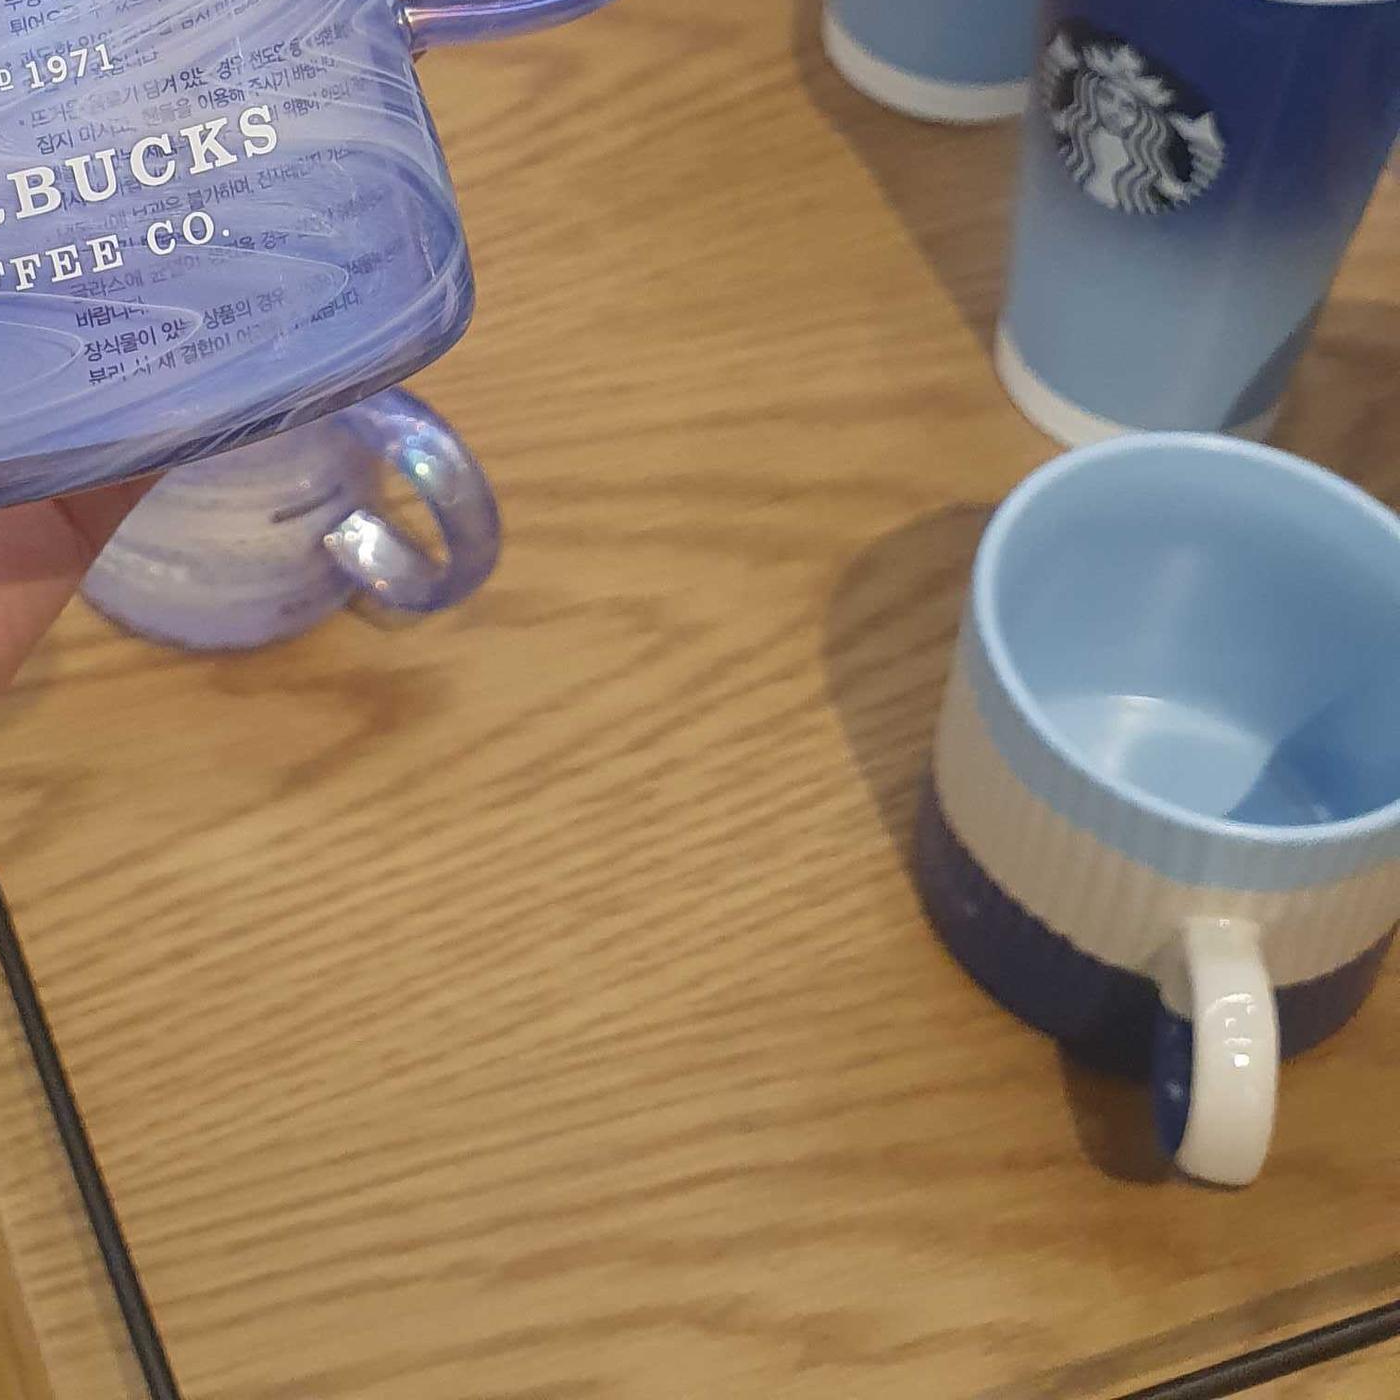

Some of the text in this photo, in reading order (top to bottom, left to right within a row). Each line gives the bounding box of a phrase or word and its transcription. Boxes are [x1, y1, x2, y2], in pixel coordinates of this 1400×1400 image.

[25, 43, 115, 89] 1971
[36, 128, 75, 155] 잡지
[198, 86, 246, 110] 이용해
[146, 211, 232, 256] CO.
[84, 326, 157, 362] 장식물이
[202, 299, 253, 330] 상품의
